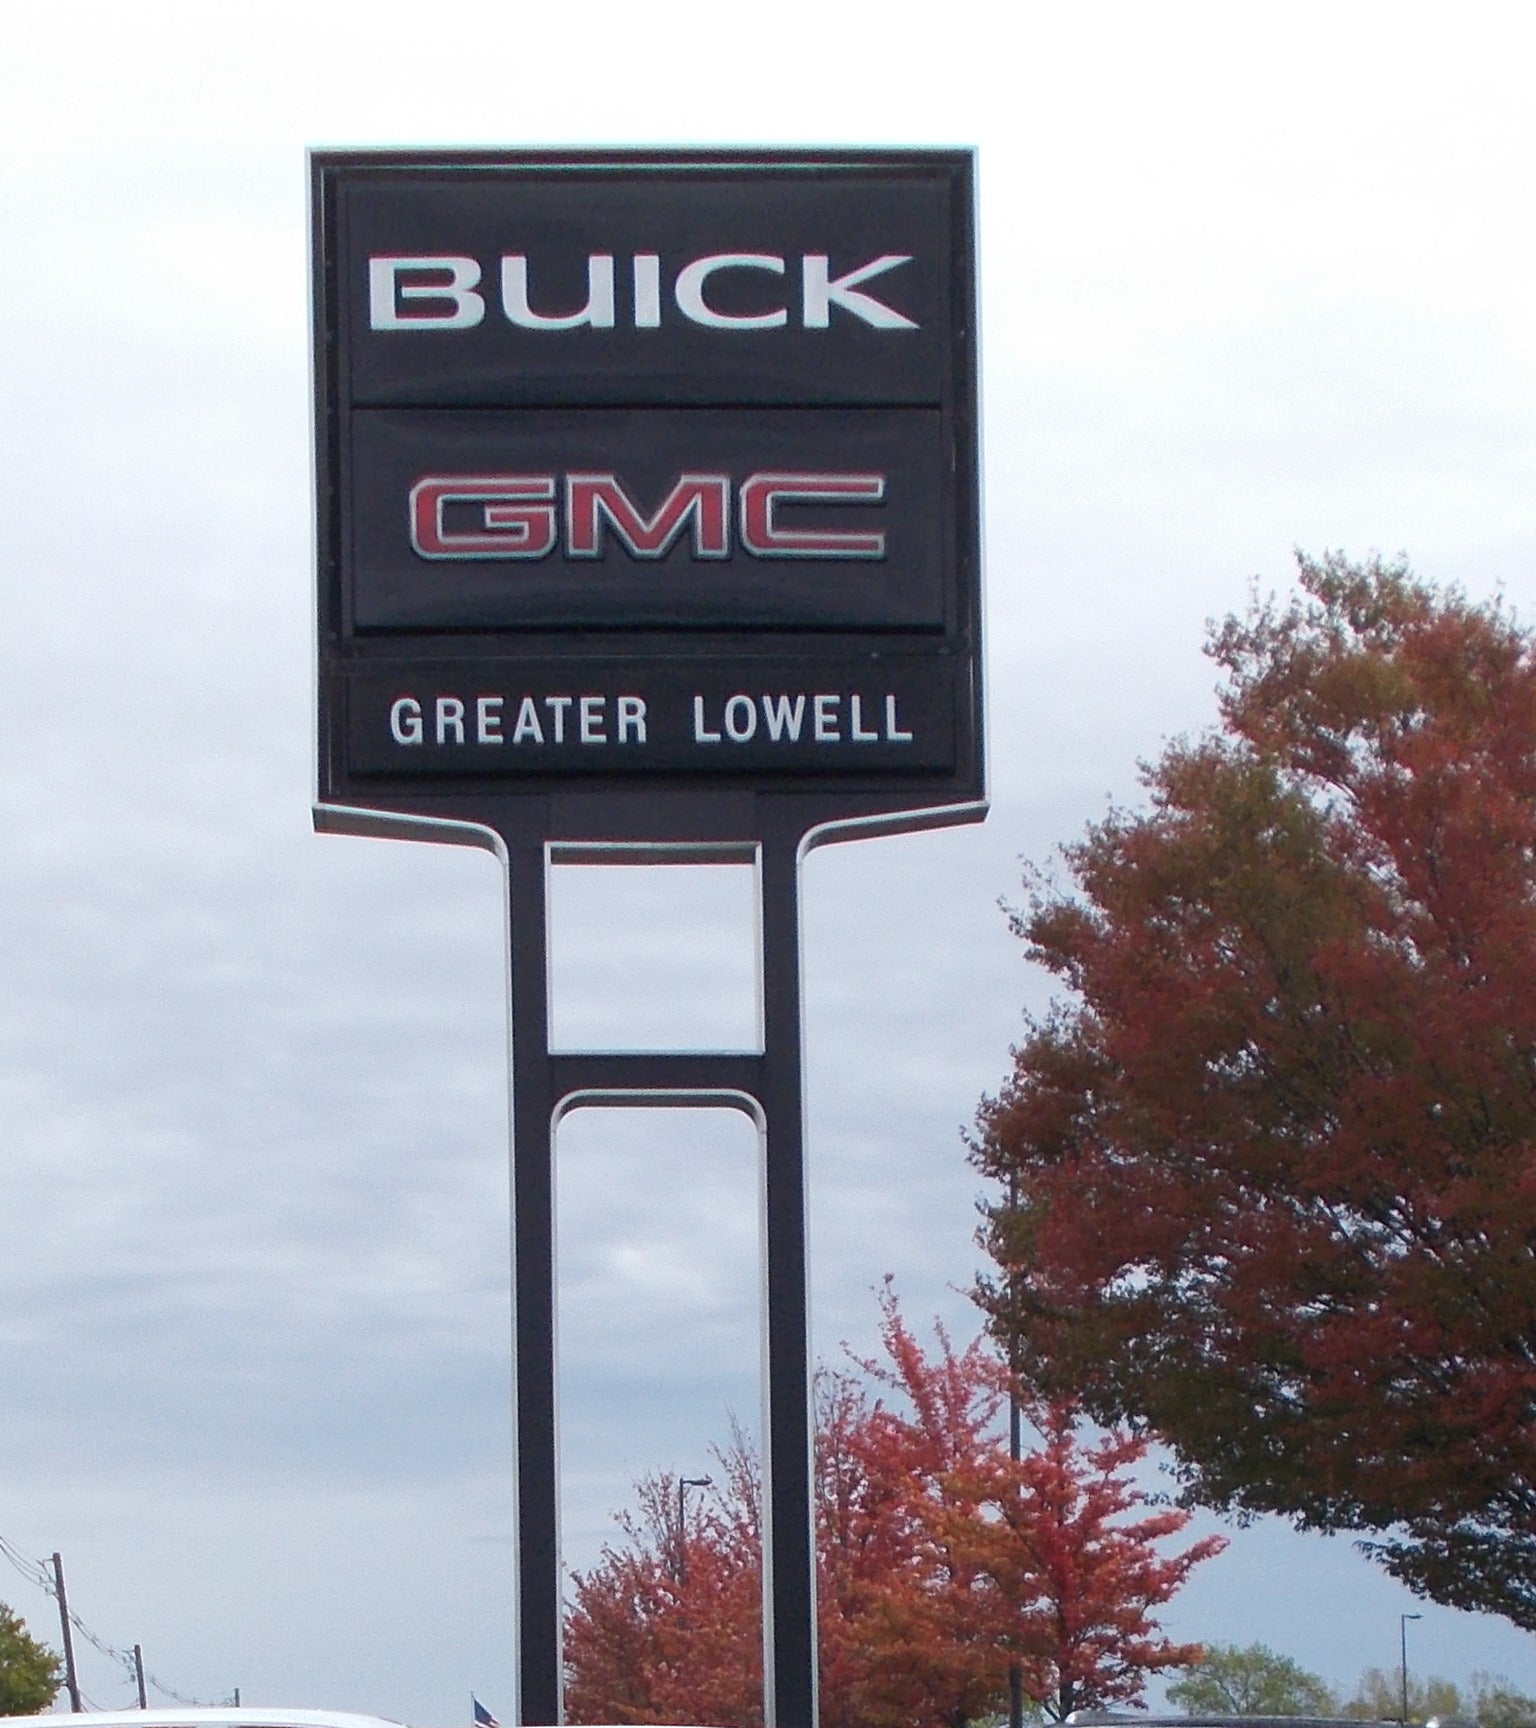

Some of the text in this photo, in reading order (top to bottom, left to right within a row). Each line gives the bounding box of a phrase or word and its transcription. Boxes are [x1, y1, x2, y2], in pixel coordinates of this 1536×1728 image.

[369, 253, 921, 330] BUICK
[409, 473, 886, 561] GMC
[389, 694, 913, 746] GREATER LOWELL
